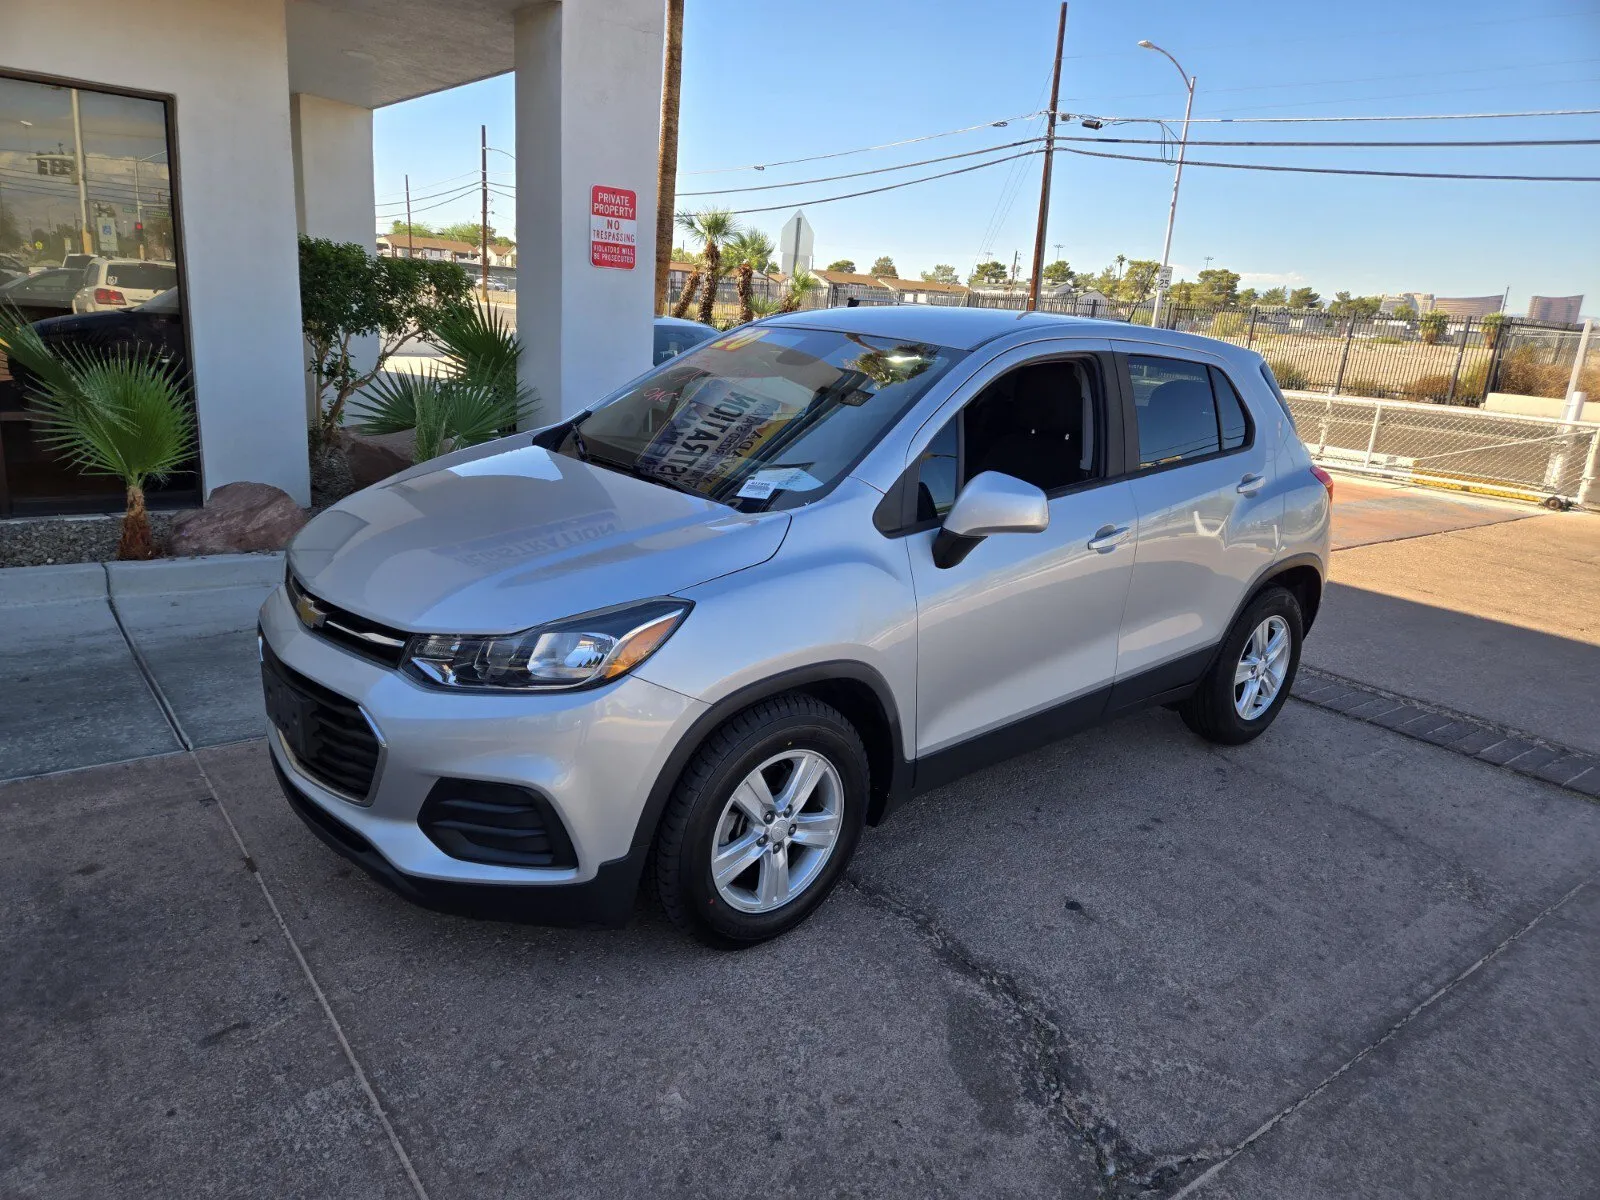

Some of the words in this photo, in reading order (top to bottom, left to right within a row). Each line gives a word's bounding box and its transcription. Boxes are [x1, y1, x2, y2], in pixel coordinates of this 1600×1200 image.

[598, 192, 630, 206] PRIVATE
[594, 203, 633, 217] PROPERTY
[606, 219, 620, 230] NO
[593, 229, 635, 243] TRESPASSING
[593, 244, 620, 254] VIOLATORS
[622, 247, 634, 256] WILL
[593, 252, 600, 260] BE
[601, 253, 634, 264] PROSECUTED
[1159, 279, 1169, 288] 25
